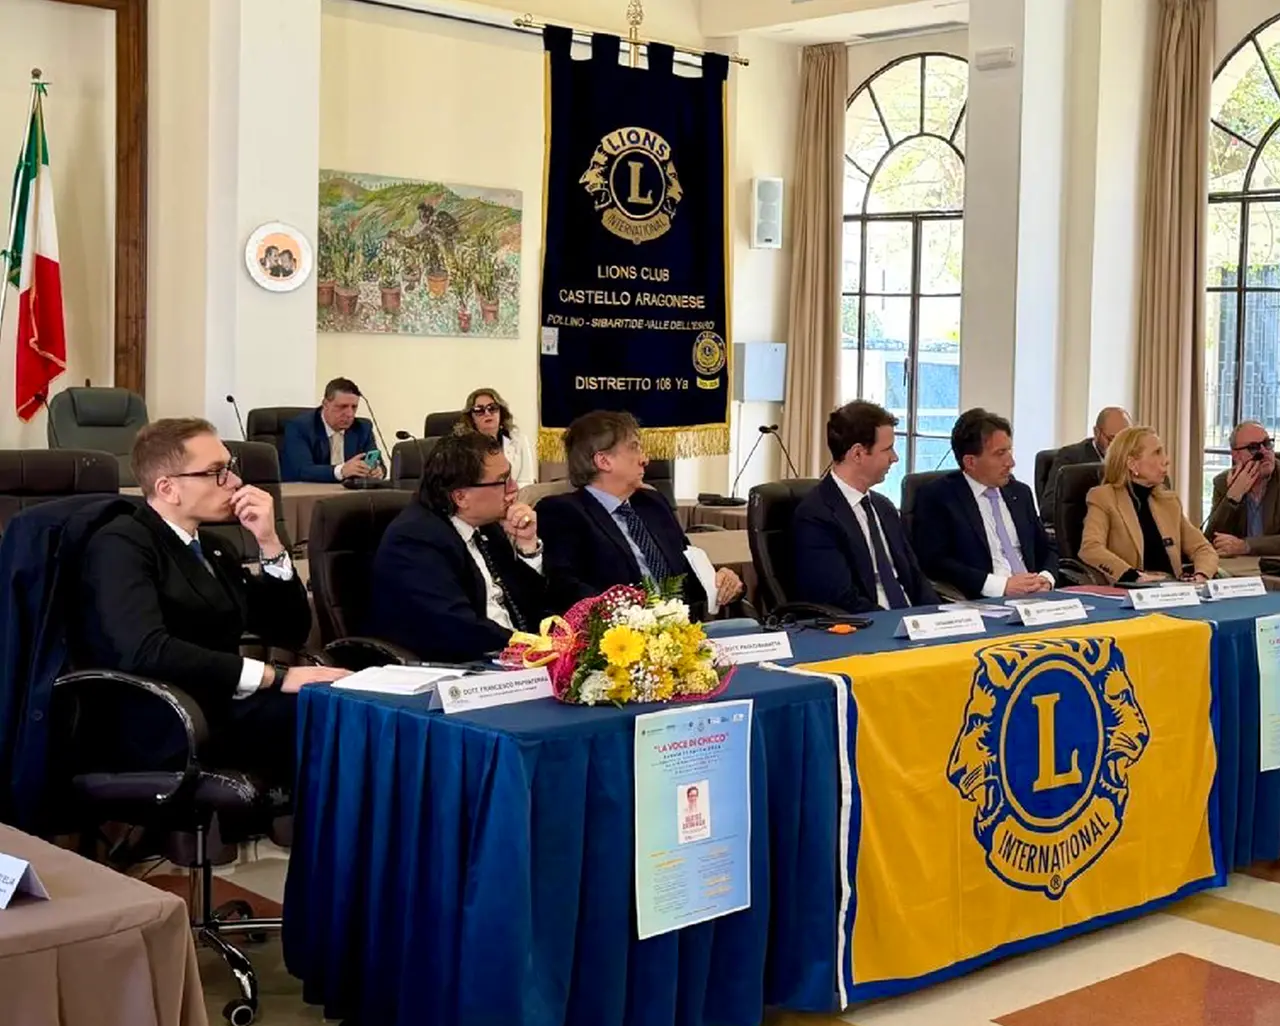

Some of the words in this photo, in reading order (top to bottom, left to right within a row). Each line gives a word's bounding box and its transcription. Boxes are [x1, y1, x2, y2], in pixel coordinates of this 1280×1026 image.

[606, 129, 668, 157] LIONS
[628, 161, 653, 205] L
[605, 213, 668, 238] INTERNATIONAL
[597, 265, 637, 279] LIONS
[640, 267, 670, 282] CLUB
[559, 289, 631, 305] CASTELLO
[635, 292, 706, 309] ARAGONESE
[547, 314, 585, 327] POLLINO
[591, 318, 644, 329] SIBARITIDE
[575, 376, 651, 391] DISTRETTO
[655, 378, 671, 390] 108
[675, 378, 689, 390] Ya
[1031, 692, 1083, 793] L
[998, 812, 1110, 874] INTERNATIONAL
